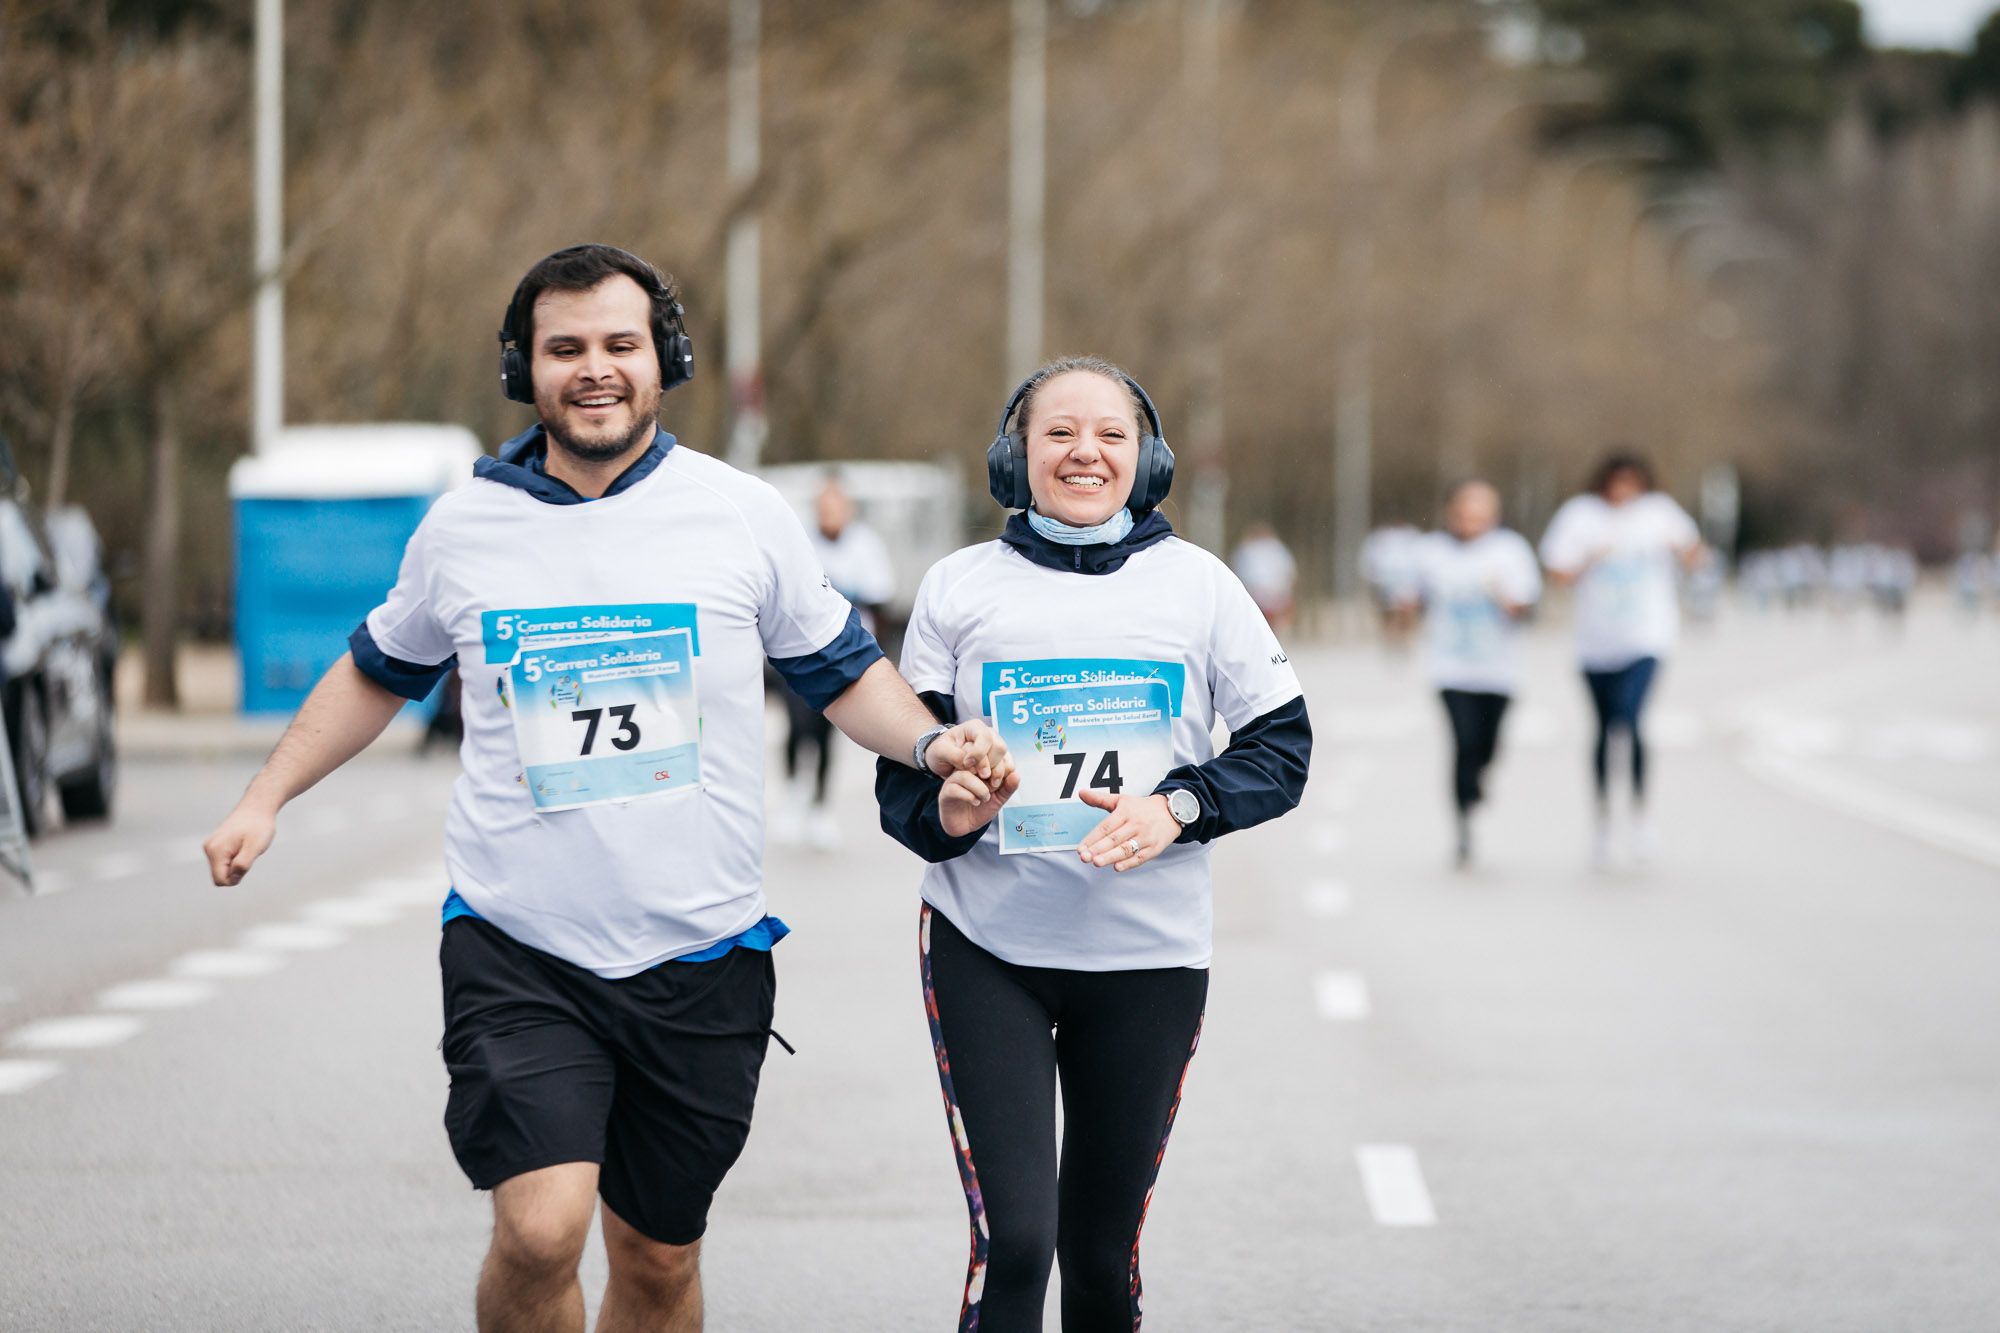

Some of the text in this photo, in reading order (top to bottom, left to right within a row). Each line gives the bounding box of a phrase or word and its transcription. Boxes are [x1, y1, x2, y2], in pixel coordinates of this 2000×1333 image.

[516, 619, 577, 633] Carrera
[581, 615, 652, 629] Solidaria
[544, 658, 598, 673] Carrera
[601, 650, 662, 666] Solidaria
[1021, 672, 1077, 685] Carrera
[1080, 670, 1144, 682] Solidaria
[1032, 702, 1084, 716] Carrera
[1087, 697, 1147, 711] Solidaria
[571, 703, 641, 756] 73
[1053, 750, 1124, 800] 74
